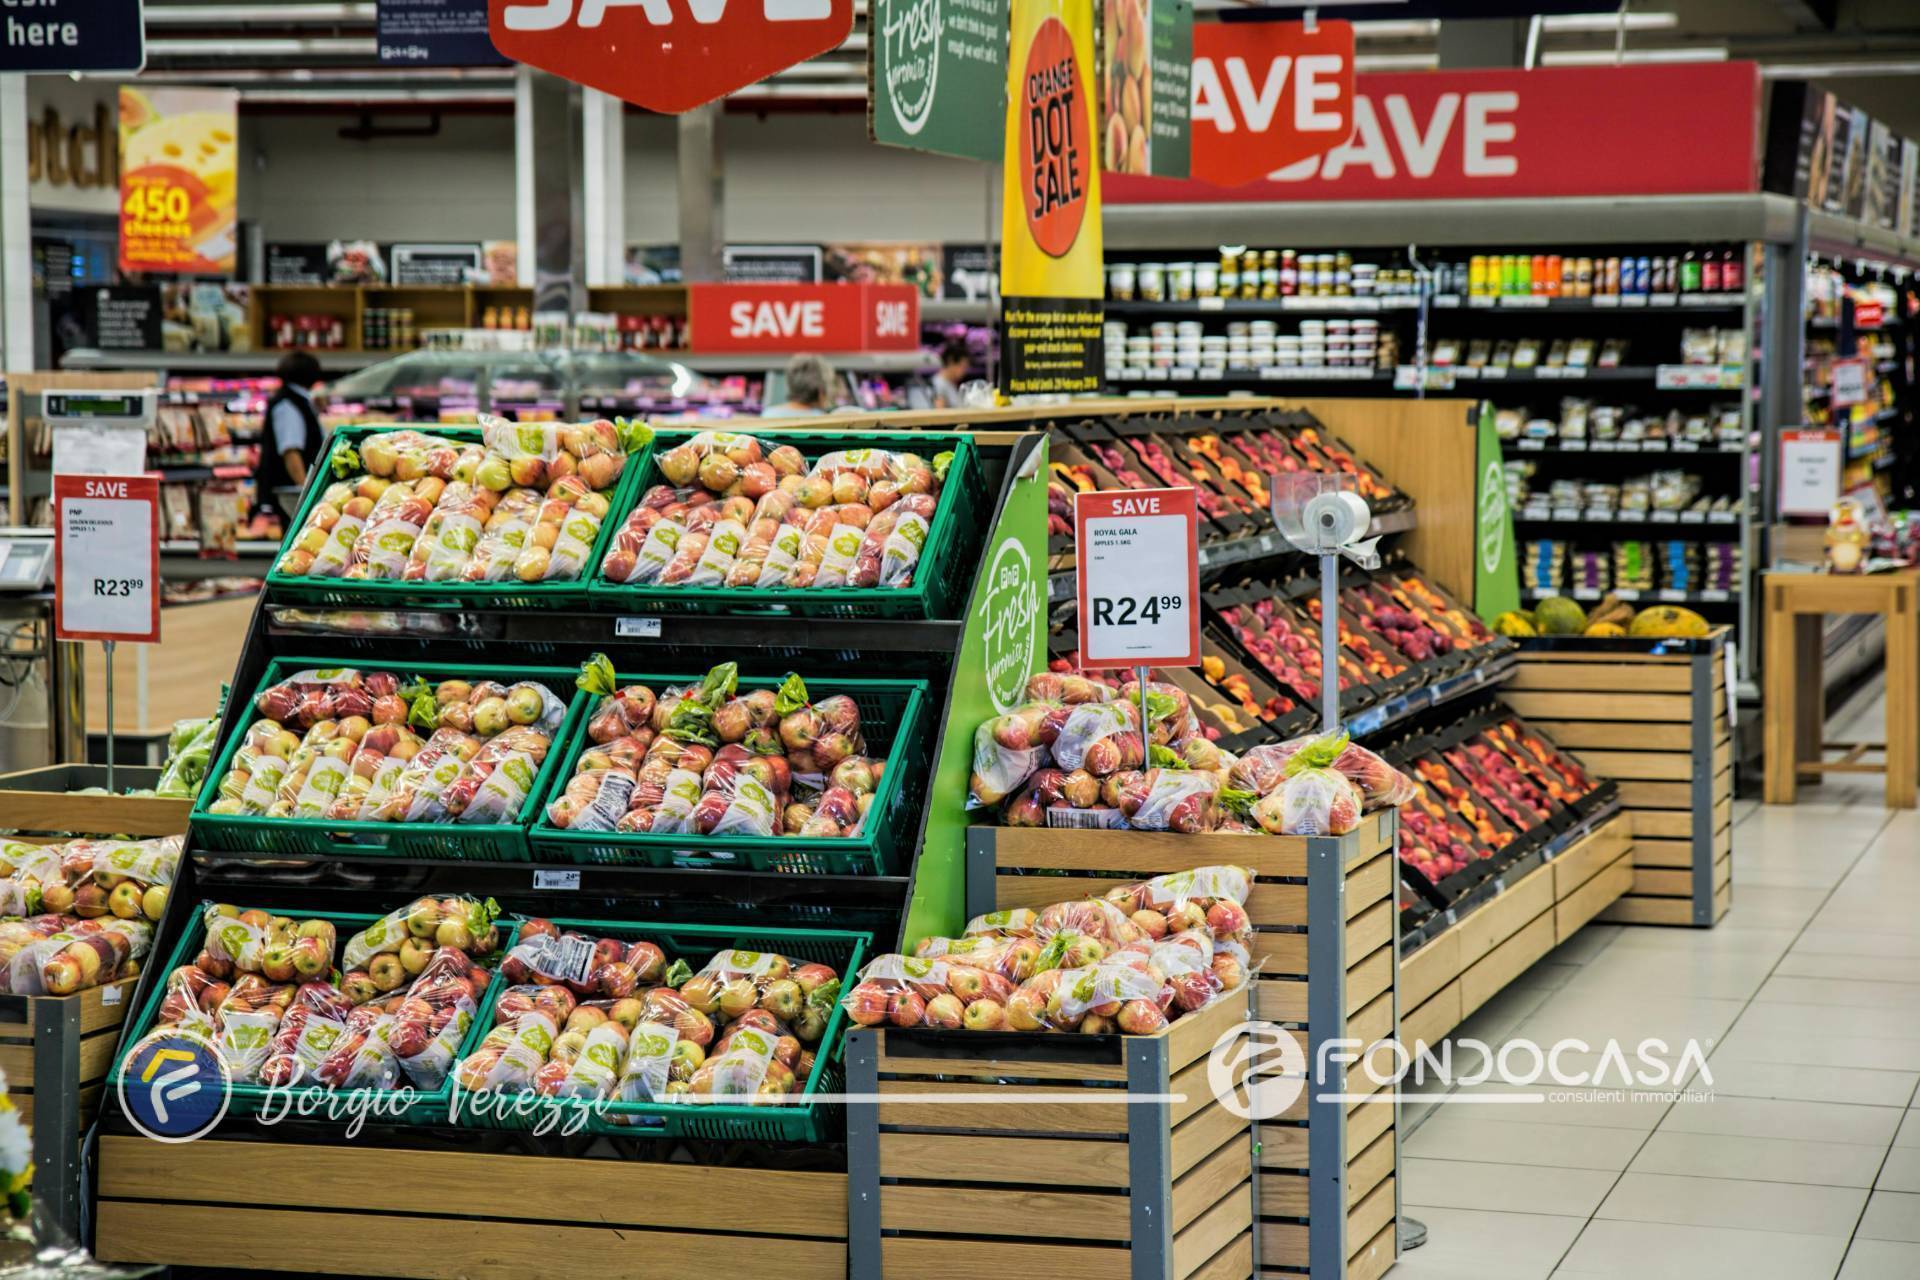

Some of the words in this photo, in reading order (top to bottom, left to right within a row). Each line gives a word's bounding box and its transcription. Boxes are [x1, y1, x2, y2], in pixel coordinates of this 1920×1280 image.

[7, 15, 79, 46] here
[1028, 58, 1073, 104] ORANGE
[1030, 91, 1074, 166] DOT
[1266, 91, 1519, 181] AVE
[1032, 149, 1082, 220] SALE
[123, 186, 190, 222] 450
[730, 301, 825, 338] SAVE
[875, 301, 909, 337] SAVE
[85, 481, 128, 498] SAVE
[1112, 497, 1161, 516] SAVE
[1093, 529, 1117, 538] ROYAL
[1118, 528, 1138, 537] GALA
[1094, 539, 1114, 547] APPLES
[1001, 563, 1020, 590] PnP
[978, 555, 1041, 653] Fresh
